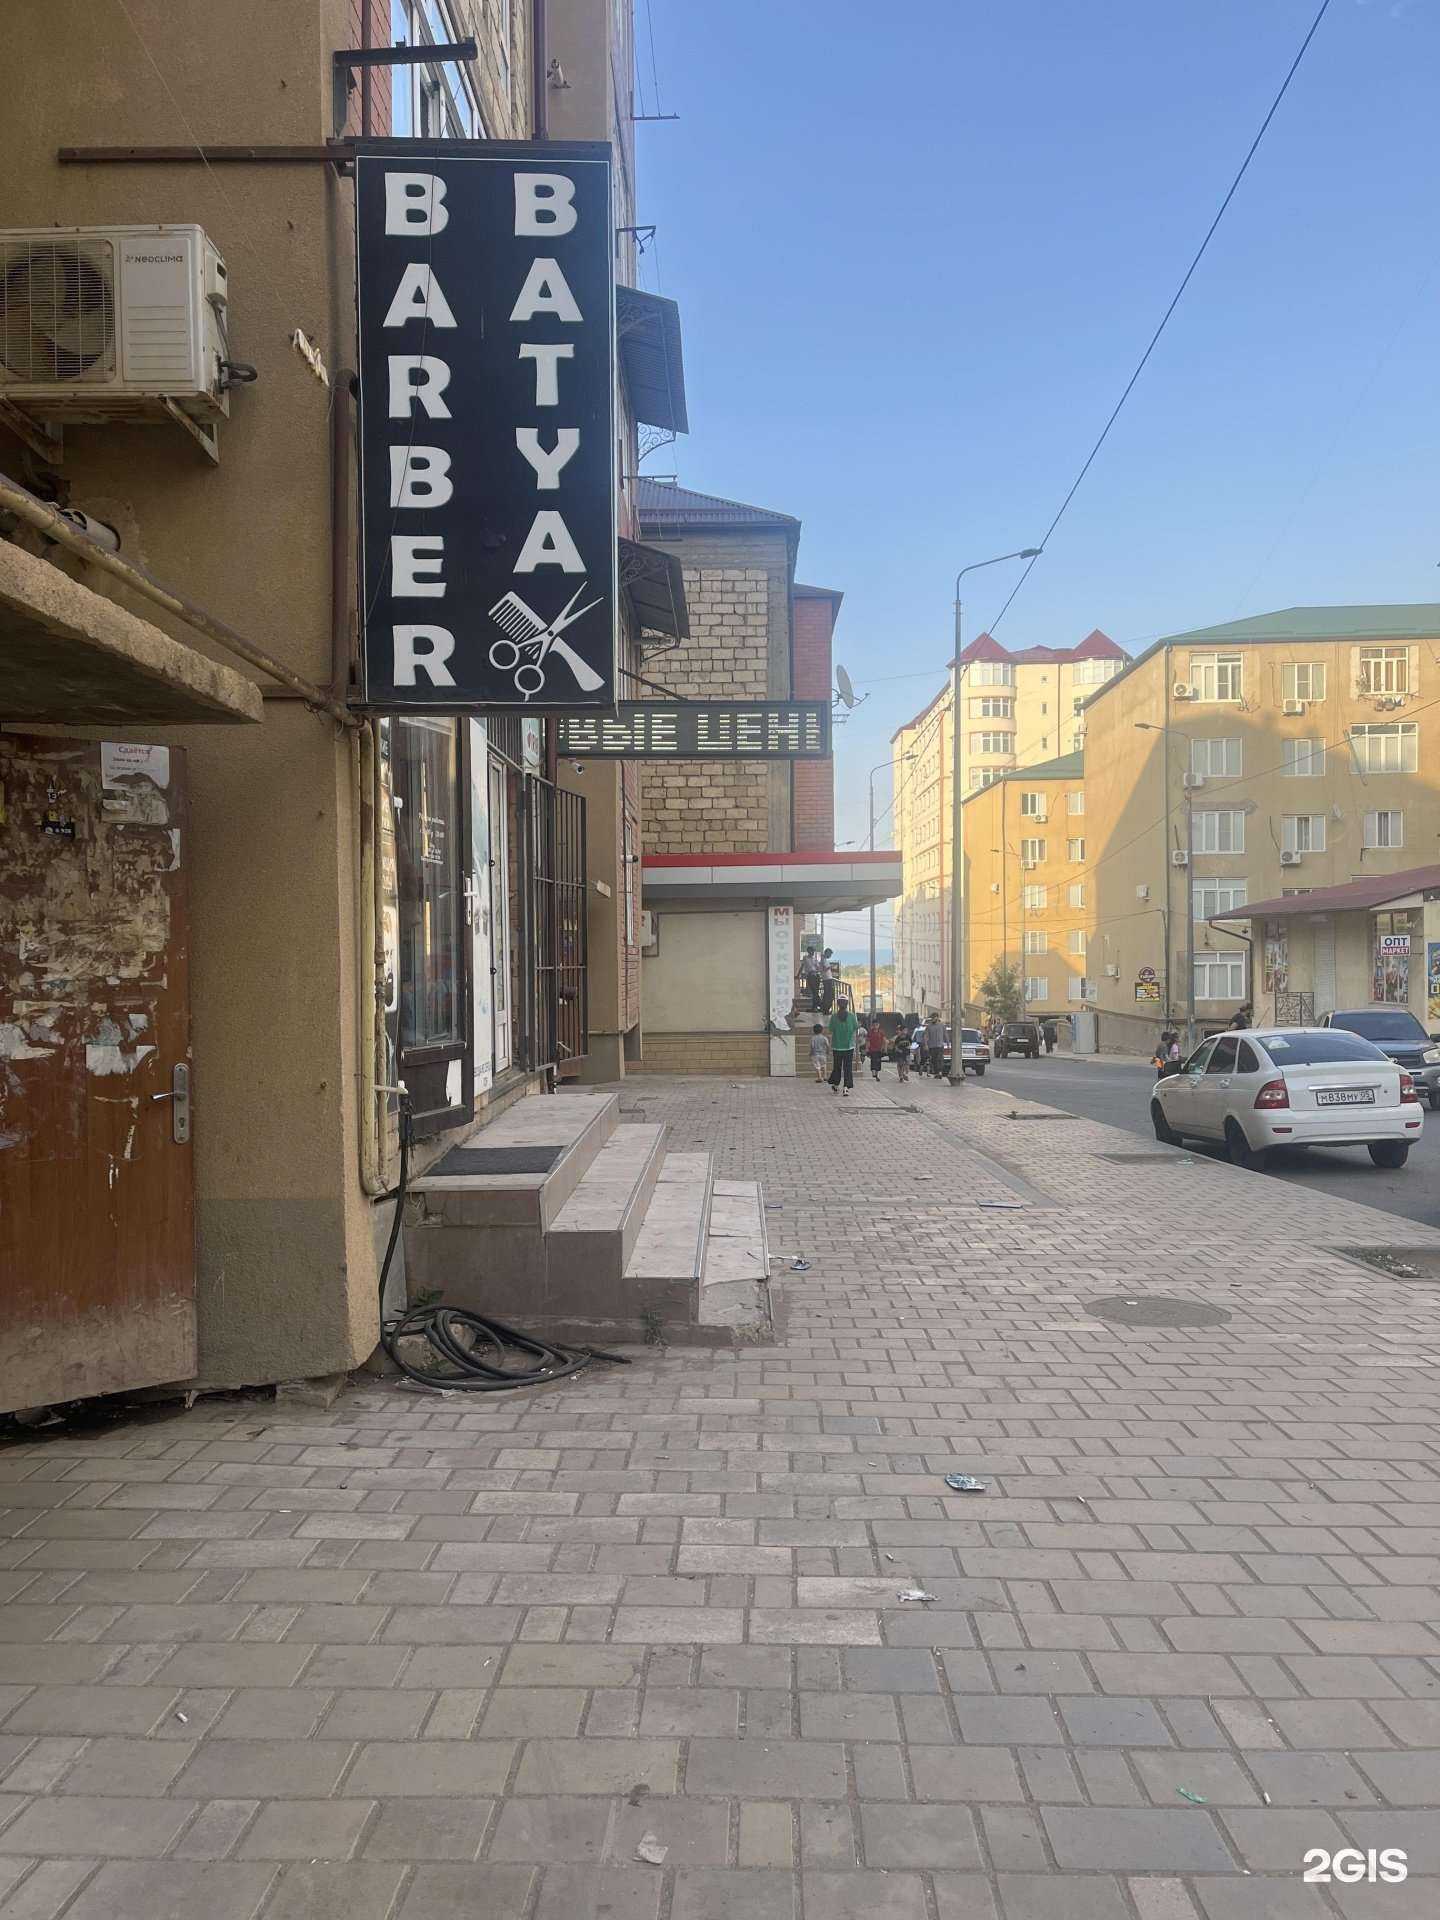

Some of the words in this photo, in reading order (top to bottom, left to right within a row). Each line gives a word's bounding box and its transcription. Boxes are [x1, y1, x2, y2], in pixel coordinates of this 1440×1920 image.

[383, 172, 458, 687] BARBER
[509, 172, 587, 573] BATYA
[559, 714, 678, 750] ВЫЕ
[1384, 937, 1408, 946] ОПТ
